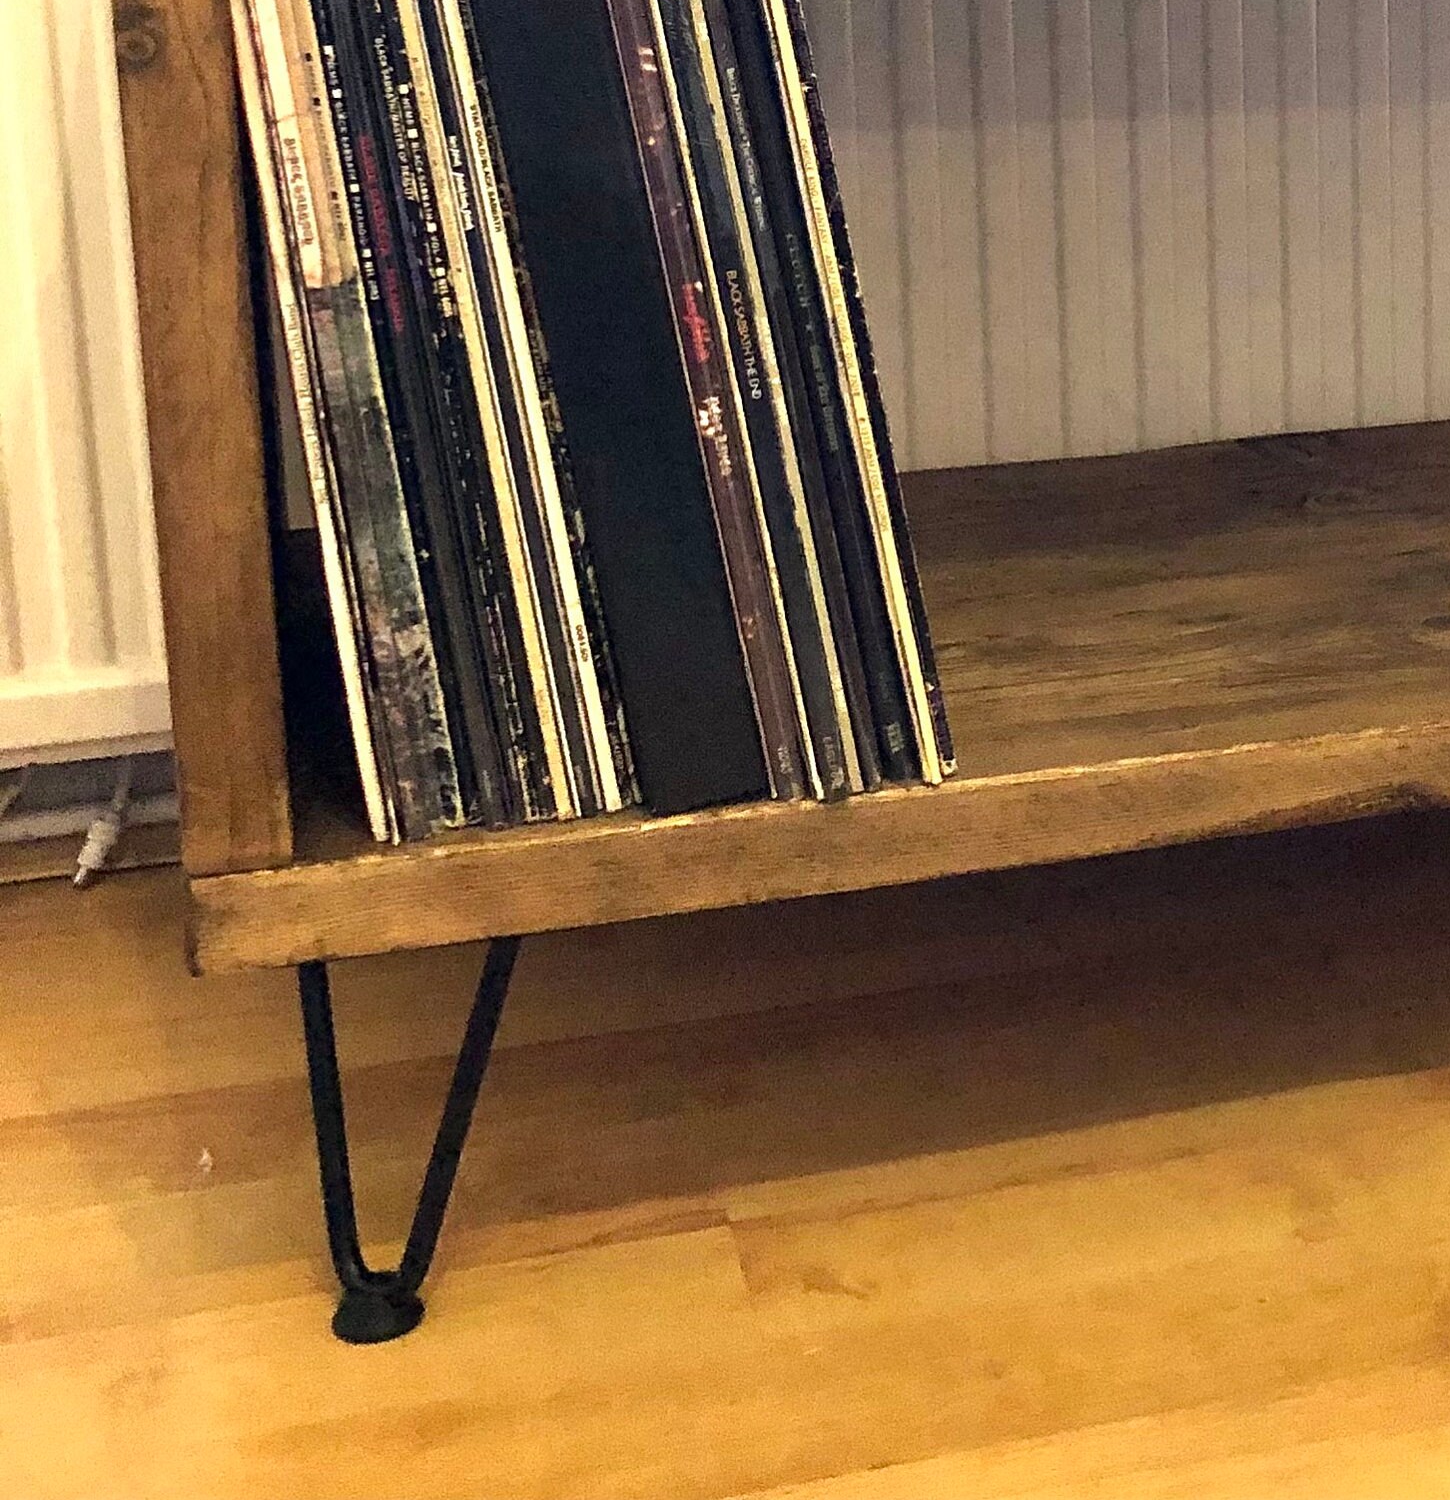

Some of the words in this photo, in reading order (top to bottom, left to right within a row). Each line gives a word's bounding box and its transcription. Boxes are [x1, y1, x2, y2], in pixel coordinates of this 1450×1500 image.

[334, 100, 348, 134] BLACK
[341, 135, 356, 181] SABBATH
[469, 104, 479, 127] STAR
[487, 190, 501, 233] SABBATH
[411, 141, 423, 173] BLACK
[417, 174, 433, 221] SABBATH
[430, 235, 440, 254] VOL
[726, 269, 742, 305] BLACK
[733, 305, 753, 355] SABBATH
[744, 356, 757, 378] THE
[748, 377, 762, 400] END
